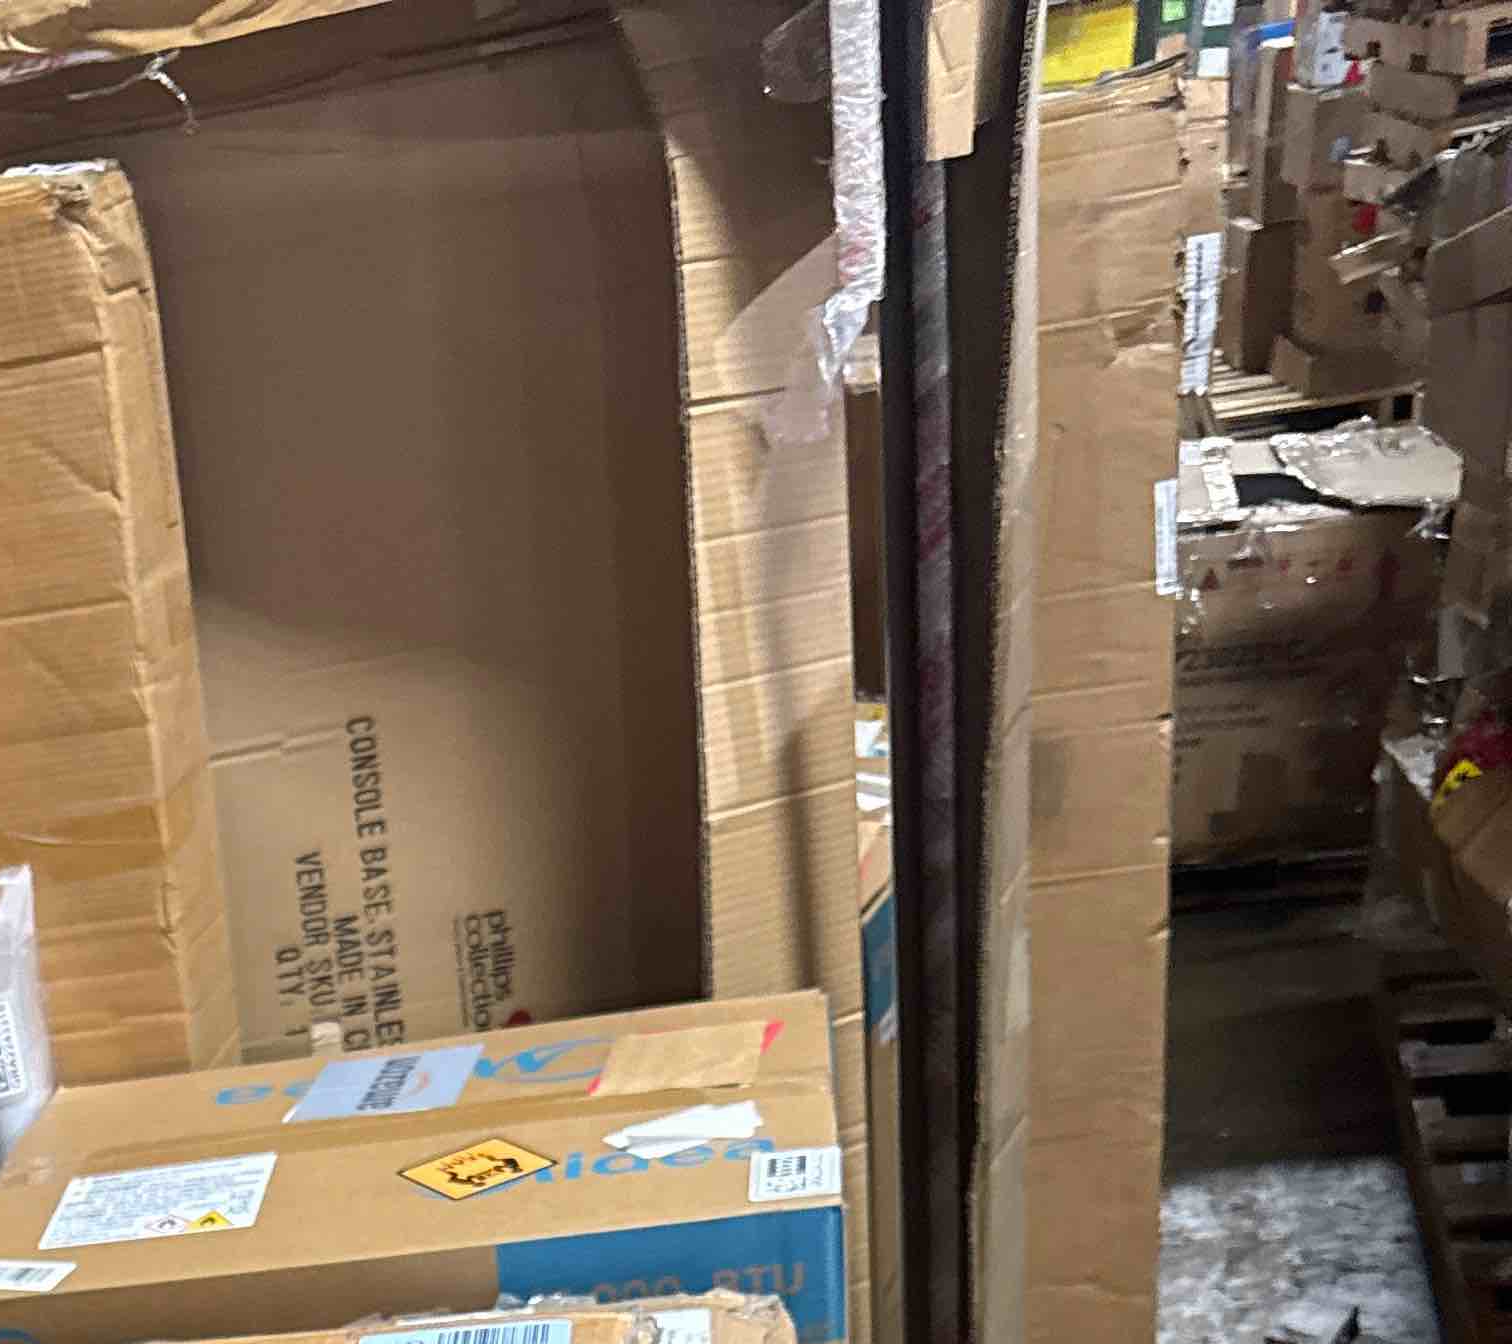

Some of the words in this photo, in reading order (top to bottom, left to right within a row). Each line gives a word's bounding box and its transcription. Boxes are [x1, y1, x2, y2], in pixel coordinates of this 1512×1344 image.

[346, 714, 385, 839] CONSOLE
[295, 848, 331, 948] VENDOR
[303, 958, 337, 1008] SKU
[335, 912, 364, 983] MADE
[465, 912, 491, 1032] collectio
[482, 910, 515, 1001] phillips
[343, 994, 368, 1018] IN
